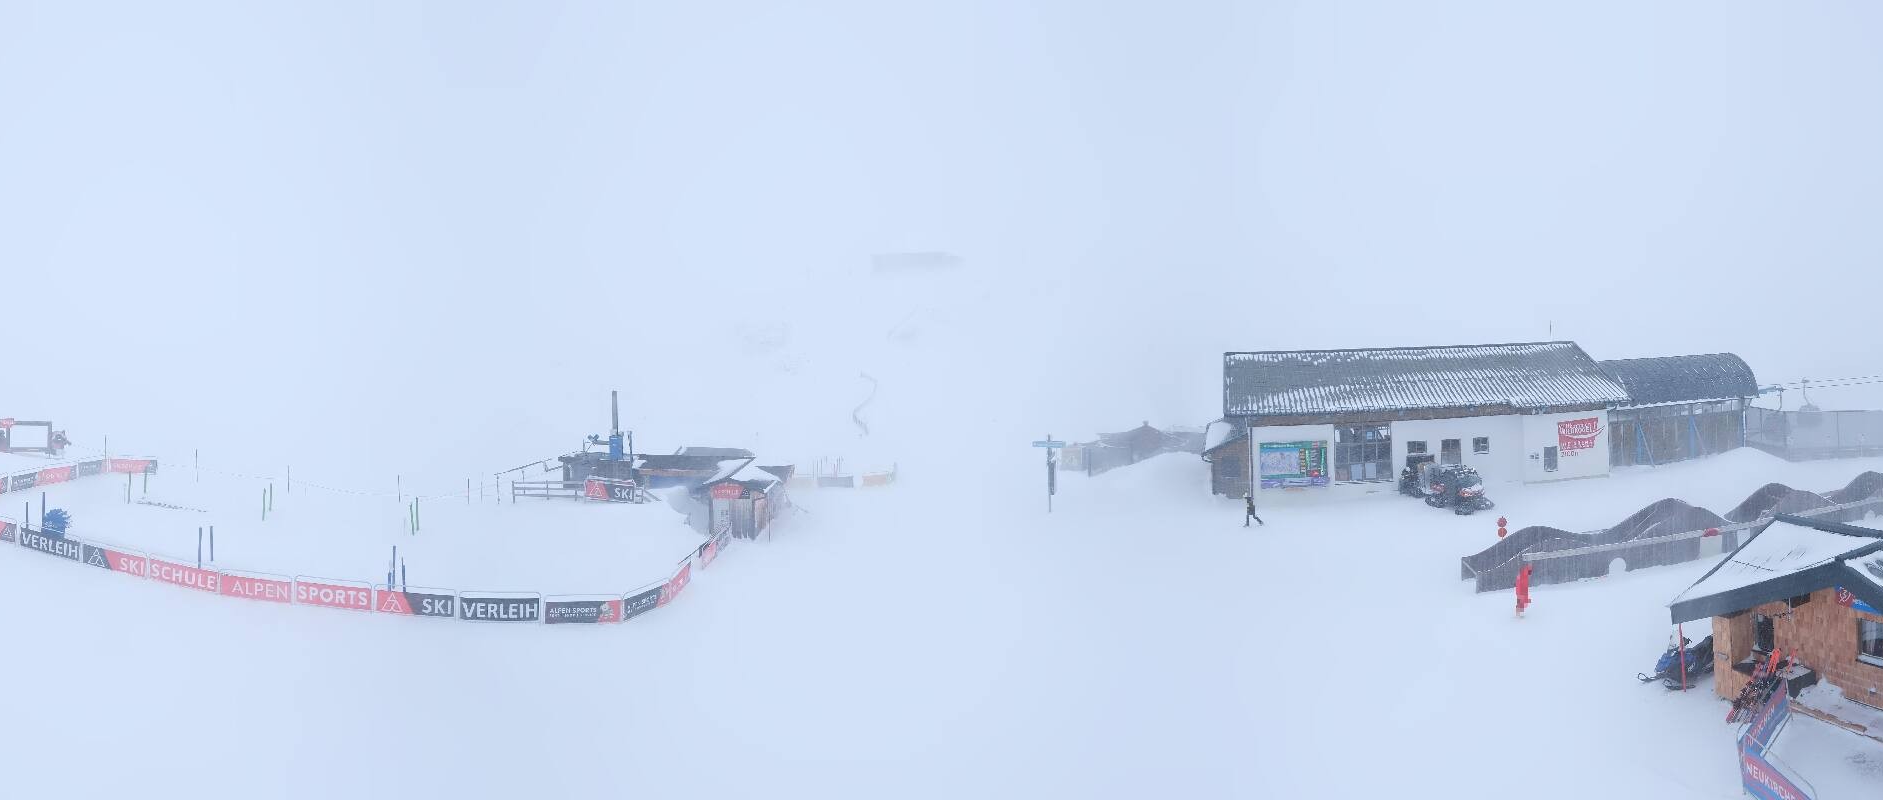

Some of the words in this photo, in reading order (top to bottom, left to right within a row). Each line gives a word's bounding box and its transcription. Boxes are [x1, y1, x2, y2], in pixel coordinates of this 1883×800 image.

[614, 487, 633, 500] SKI
[21, 532, 80, 561] VERLEIH
[120, 557, 145, 576] SKI
[151, 563, 215, 590] SCHULE
[231, 580, 288, 599] ALPEN
[297, 585, 368, 606] SPORTS
[422, 598, 452, 614] SKI
[462, 602, 538, 618] VERLEIH
